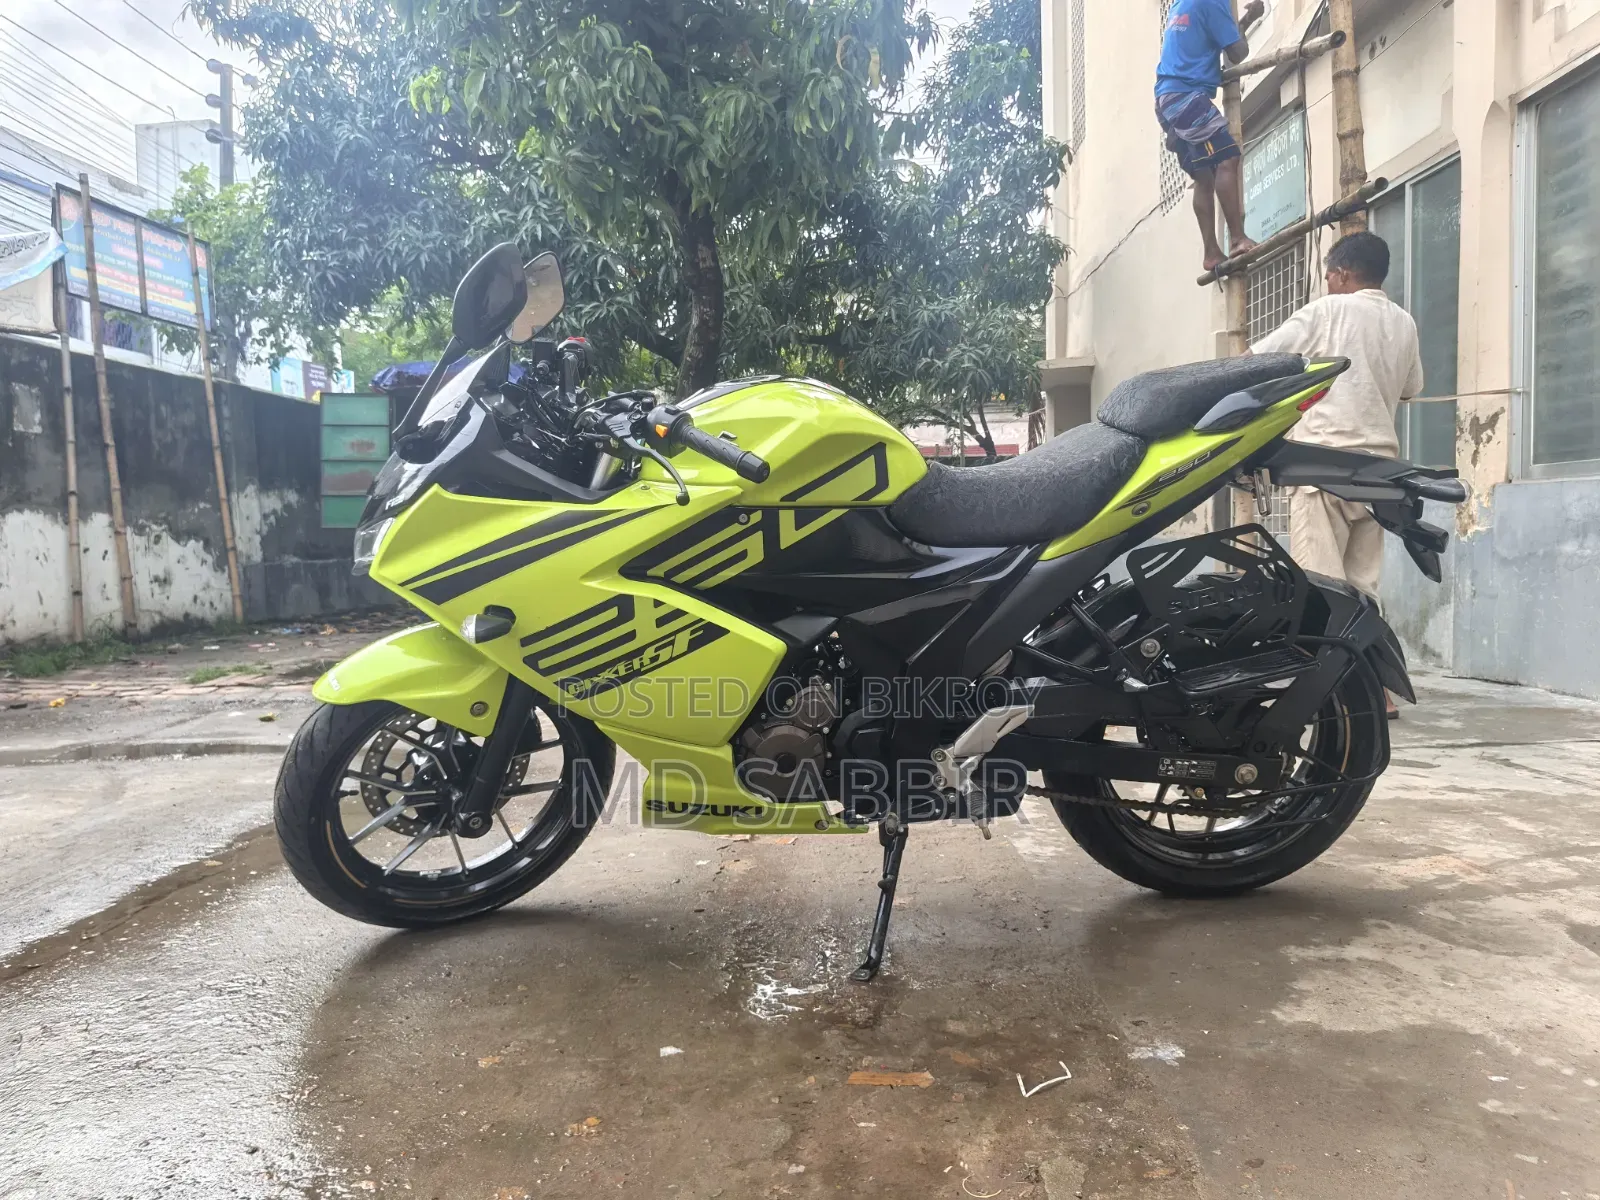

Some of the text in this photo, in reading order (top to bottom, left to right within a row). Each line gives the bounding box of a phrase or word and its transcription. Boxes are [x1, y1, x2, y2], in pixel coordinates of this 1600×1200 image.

[1263, 163, 1285, 190] SERVICES
[1286, 154, 1300, 172] LTD.
[1159, 450, 1211, 482] 250
[645, 800, 764, 818] SUZUKI
